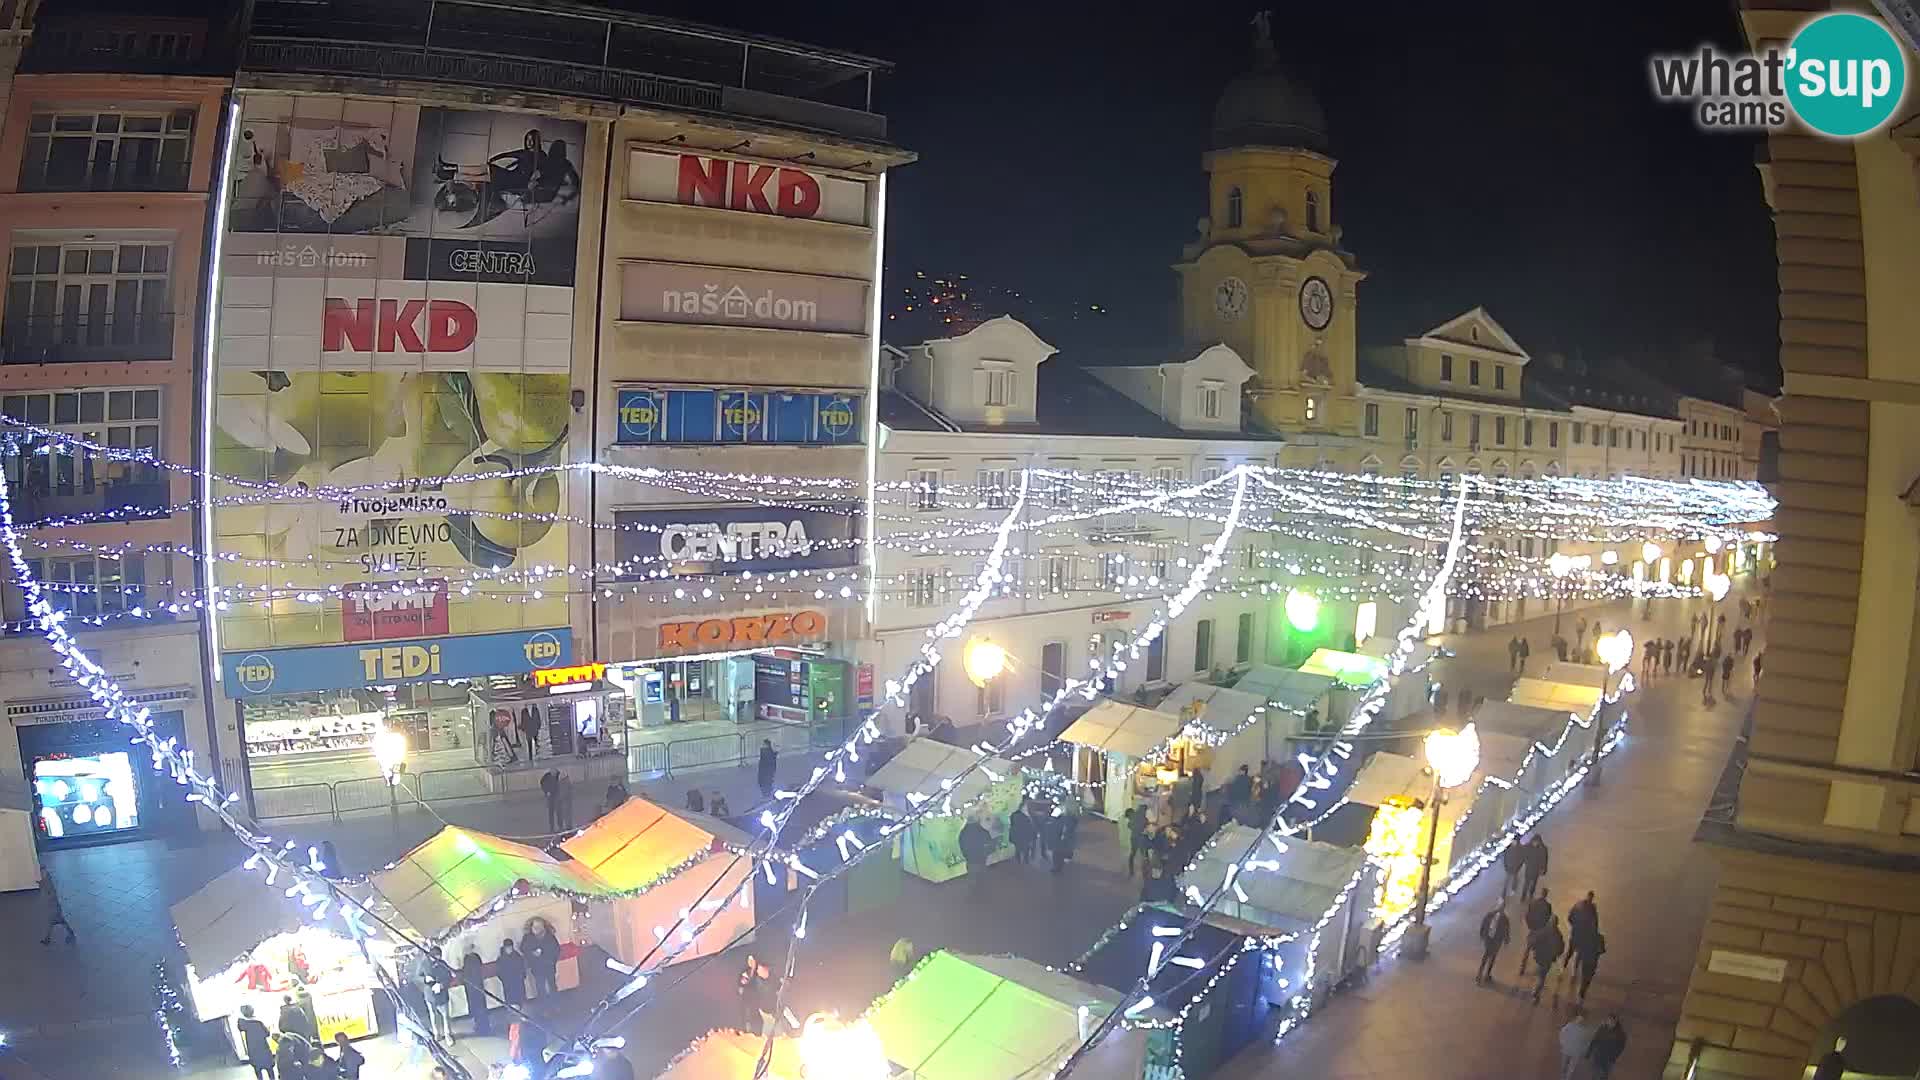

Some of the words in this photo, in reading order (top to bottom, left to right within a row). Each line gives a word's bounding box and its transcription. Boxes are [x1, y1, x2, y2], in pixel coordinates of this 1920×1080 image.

[678, 154, 821, 218] NKD
[257, 244, 296, 265] naš
[321, 246, 367, 267] dom
[450, 249, 536, 275] CENTRA
[662, 284, 719, 315] naš
[754, 289, 817, 322] dom
[322, 298, 478, 353] NKD
[339, 496, 448, 515] #TvojeMisto
[335, 527, 360, 548] ZA
[368, 522, 452, 547] DNEVNO
[660, 520, 811, 562] CENTRA
[660, 610, 826, 649] KORZO
[359, 643, 441, 681] TEDi
[523, 641, 561, 659] TEDi
[235, 664, 275, 682] TEDi
